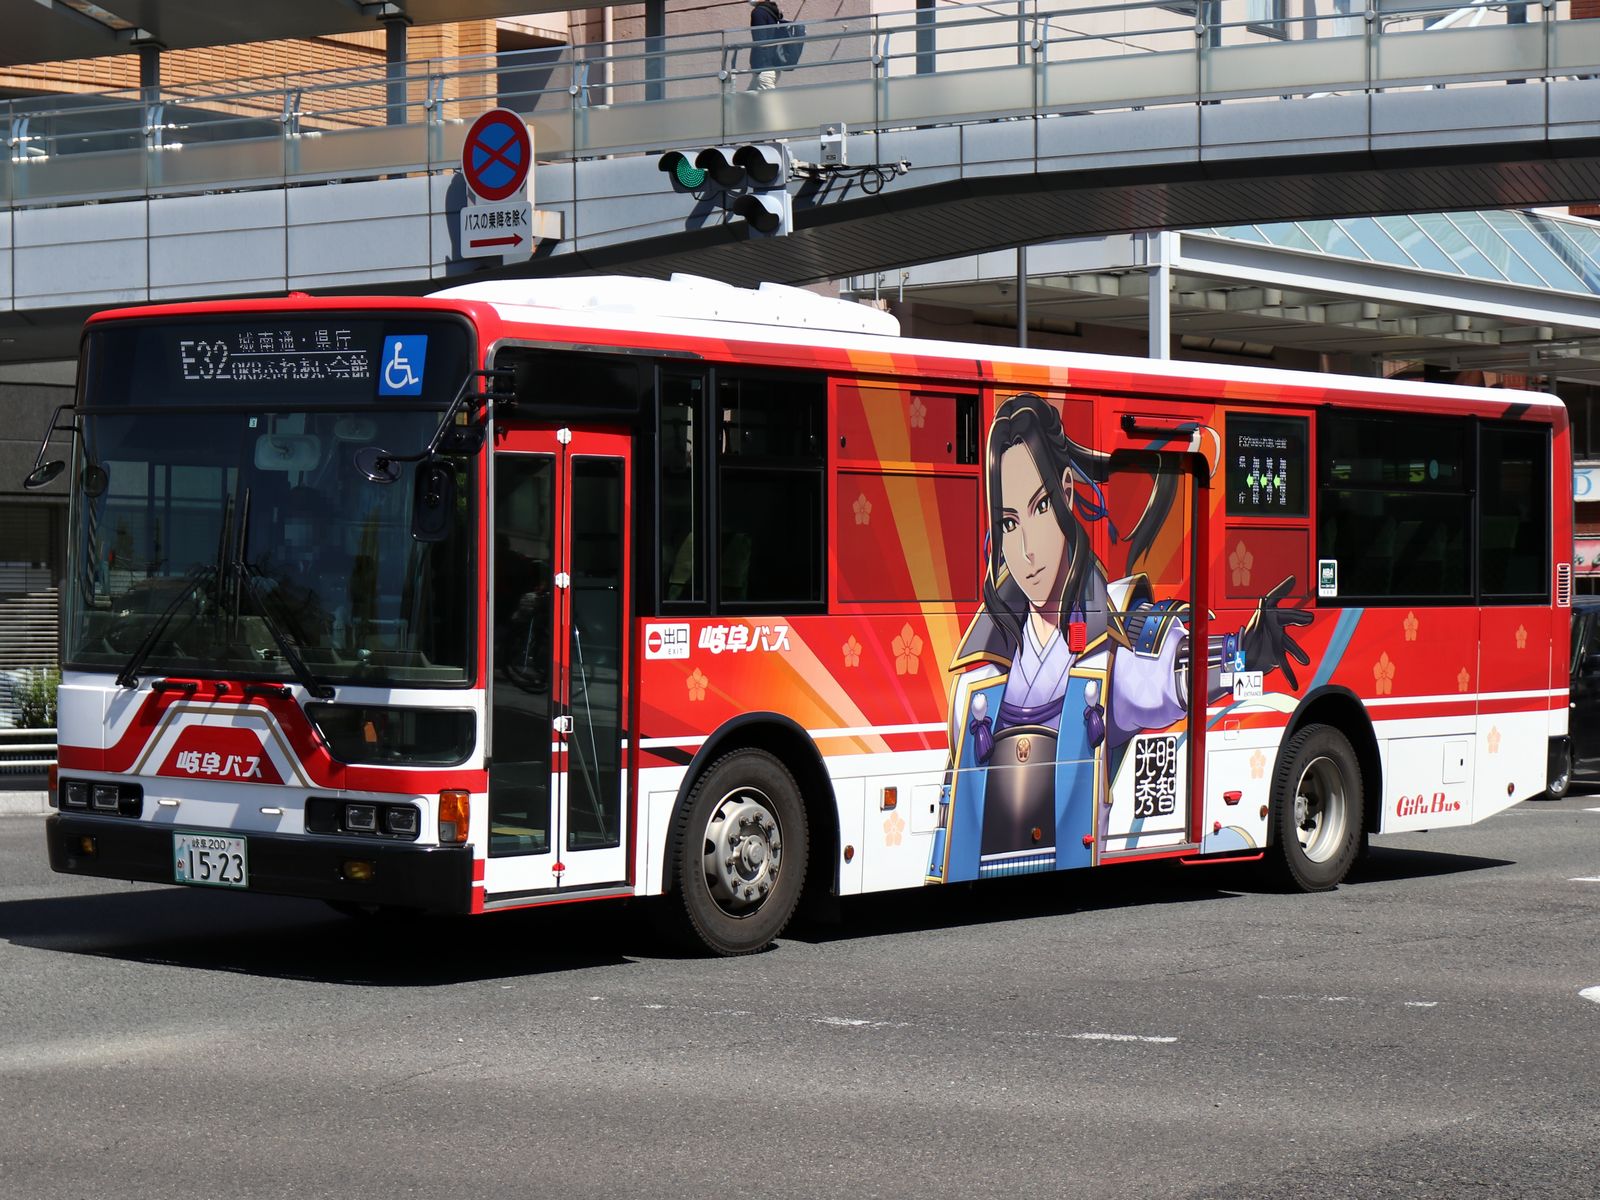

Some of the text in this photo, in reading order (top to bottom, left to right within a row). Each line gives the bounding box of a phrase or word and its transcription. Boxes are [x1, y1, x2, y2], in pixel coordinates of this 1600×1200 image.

[465, 208, 527, 231] バスの乗降を除く
[180, 340, 231, 379] E32
[664, 627, 688, 645] 出口
[698, 624, 791, 655] 岐阜バス
[1245, 675, 1262, 688] 入口
[176, 750, 263, 779] 岐阜バス
[1135, 742, 1157, 816] 光秀
[1155, 737, 1177, 814] 明智
[1396, 792, 1462, 817] Gifu Bus
[192, 838, 226, 850] 岐阜 200
[189, 849, 244, 883] 15-23
